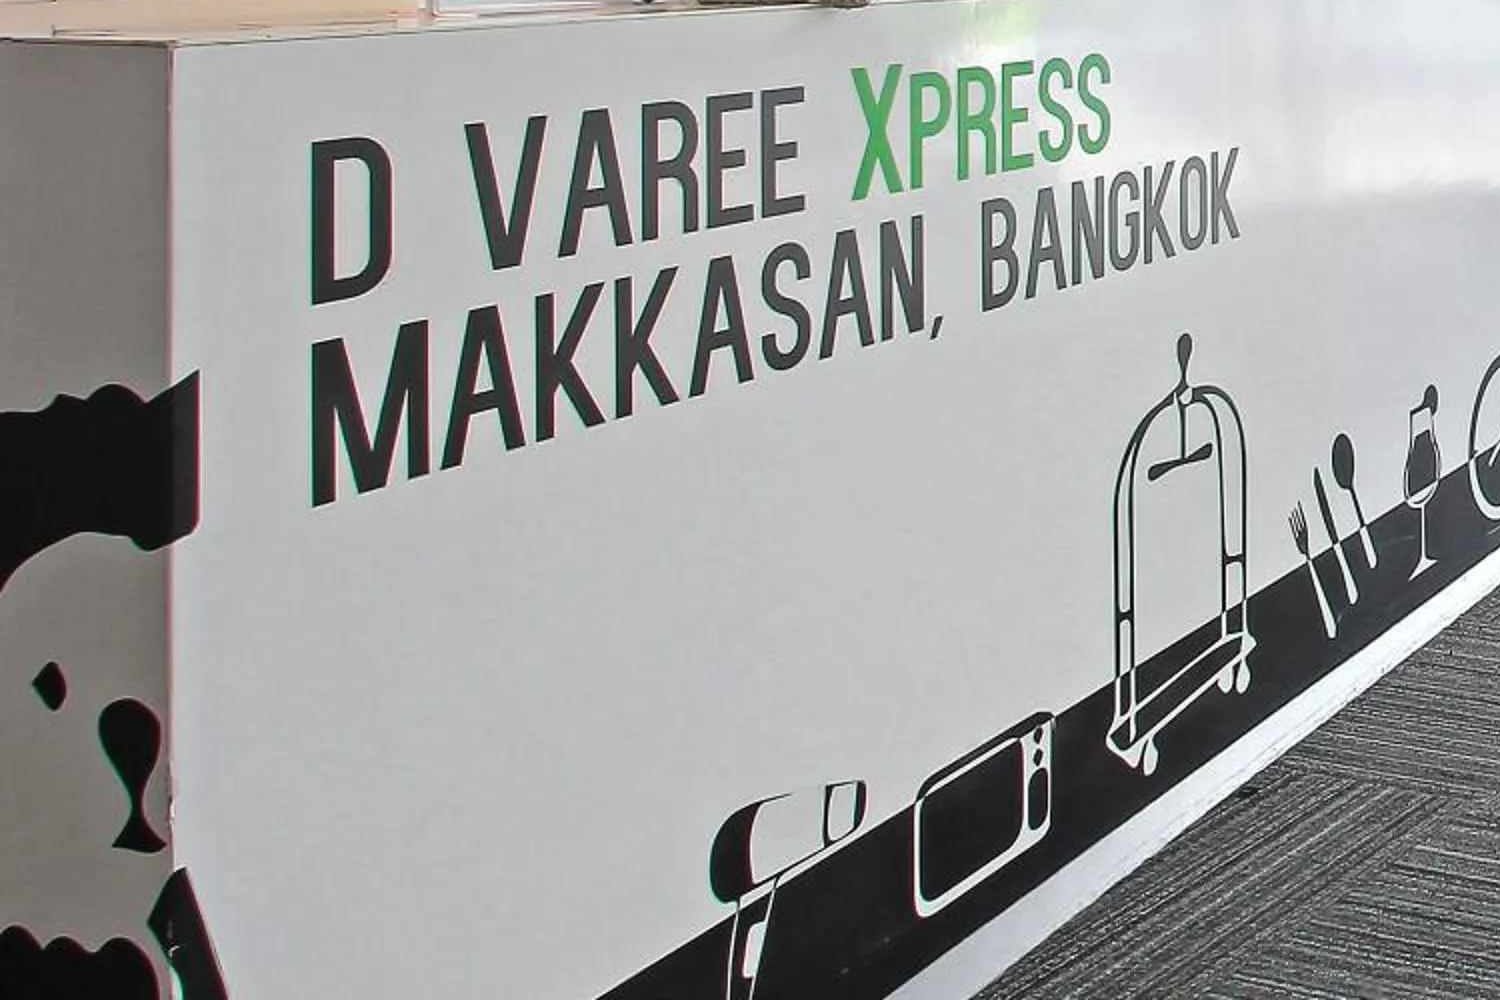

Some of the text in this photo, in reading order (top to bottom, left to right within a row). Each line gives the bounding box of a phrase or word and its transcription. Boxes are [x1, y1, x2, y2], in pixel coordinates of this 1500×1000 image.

[311, 53, 1111, 305] D VAREE XPRESS
[311, 148, 1241, 509] MAKKASAN, BANGKOK
